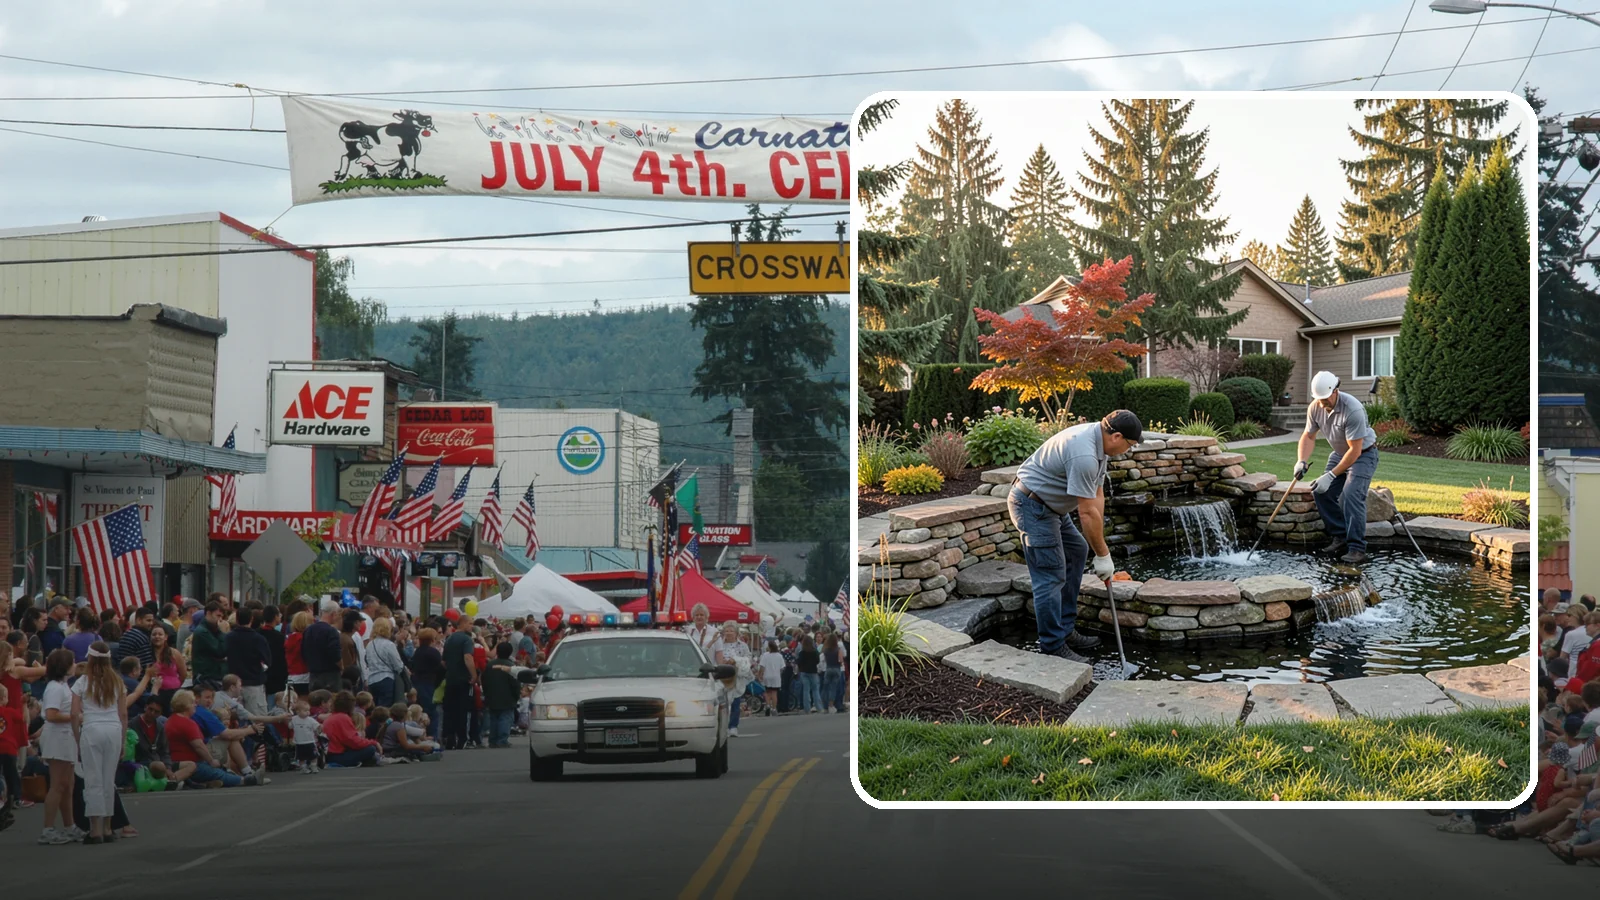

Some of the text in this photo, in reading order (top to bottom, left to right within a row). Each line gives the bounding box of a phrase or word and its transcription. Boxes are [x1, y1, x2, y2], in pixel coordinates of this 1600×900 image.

[695, 121, 850, 149] Carnat
[481, 141, 605, 192] JULY
[632, 150, 746, 197] 4th.
[697, 254, 850, 280] CROSSWA
[282, 380, 374, 420] ACE
[406, 410, 452, 422] CEDAR
[283, 421, 371, 436] Hardware
[416, 428, 477, 447] Coca-Cola
[353, 467, 386, 478] Simpl
[96, 485, 124, 494] Vincent
[126, 486, 135, 494] de
[138, 486, 155, 495] Paul
[688, 527, 741, 535] CRNATION
[699, 535, 730, 543] GLASS
